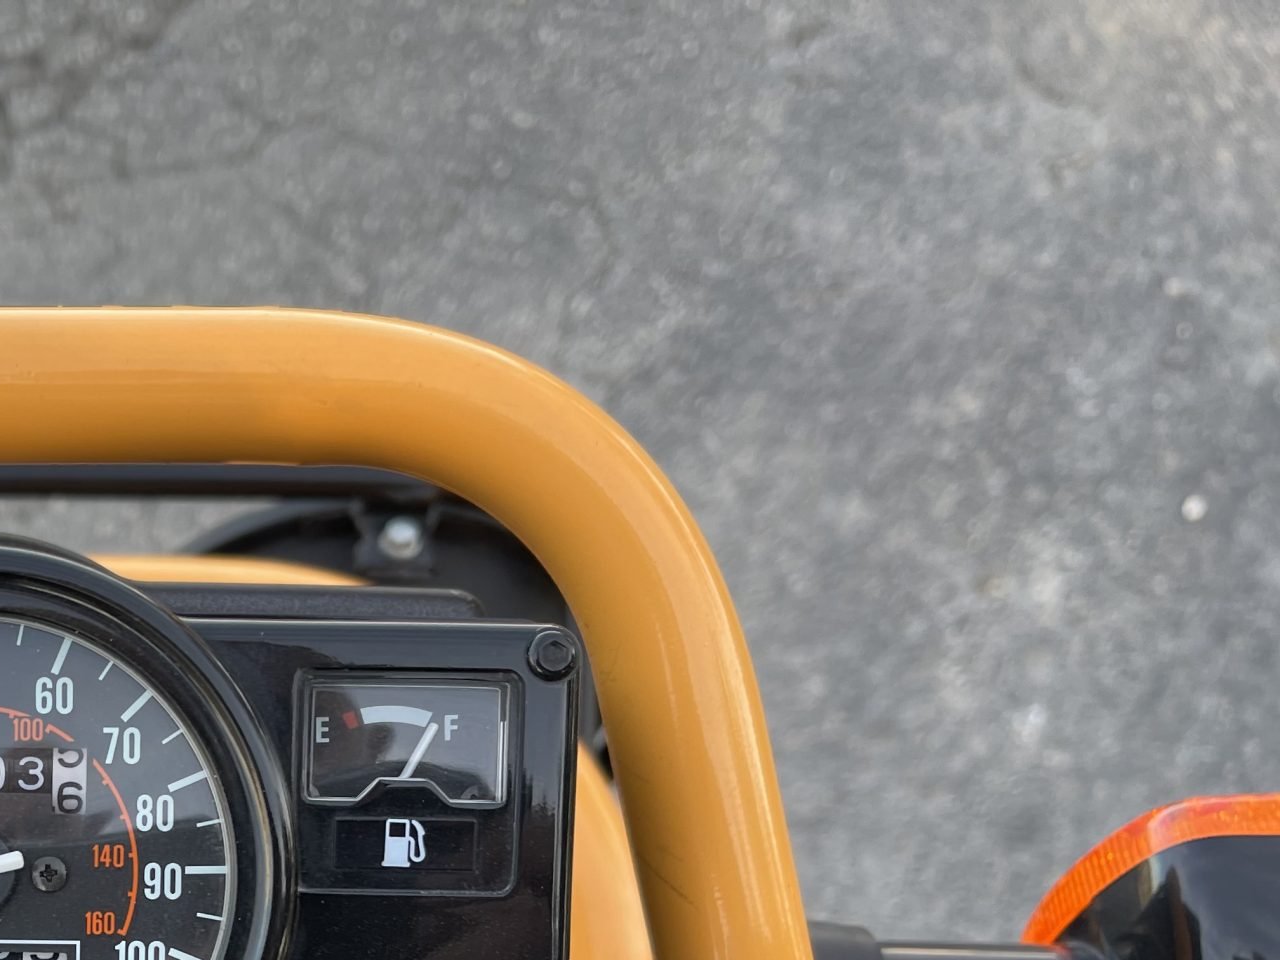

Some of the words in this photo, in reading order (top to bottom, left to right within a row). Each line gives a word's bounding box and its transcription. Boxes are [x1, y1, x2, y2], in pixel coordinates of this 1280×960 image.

[35, 677, 74, 715] 60
[13, 717, 44, 741] 100
[316, 717, 330, 743] E
[444, 715, 458, 741] F
[102, 726, 141, 765] 70
[136, 794, 175, 832] 80
[92, 845, 124, 869] 140
[143, 862, 182, 900] 90
[85, 911, 115, 935] 160
